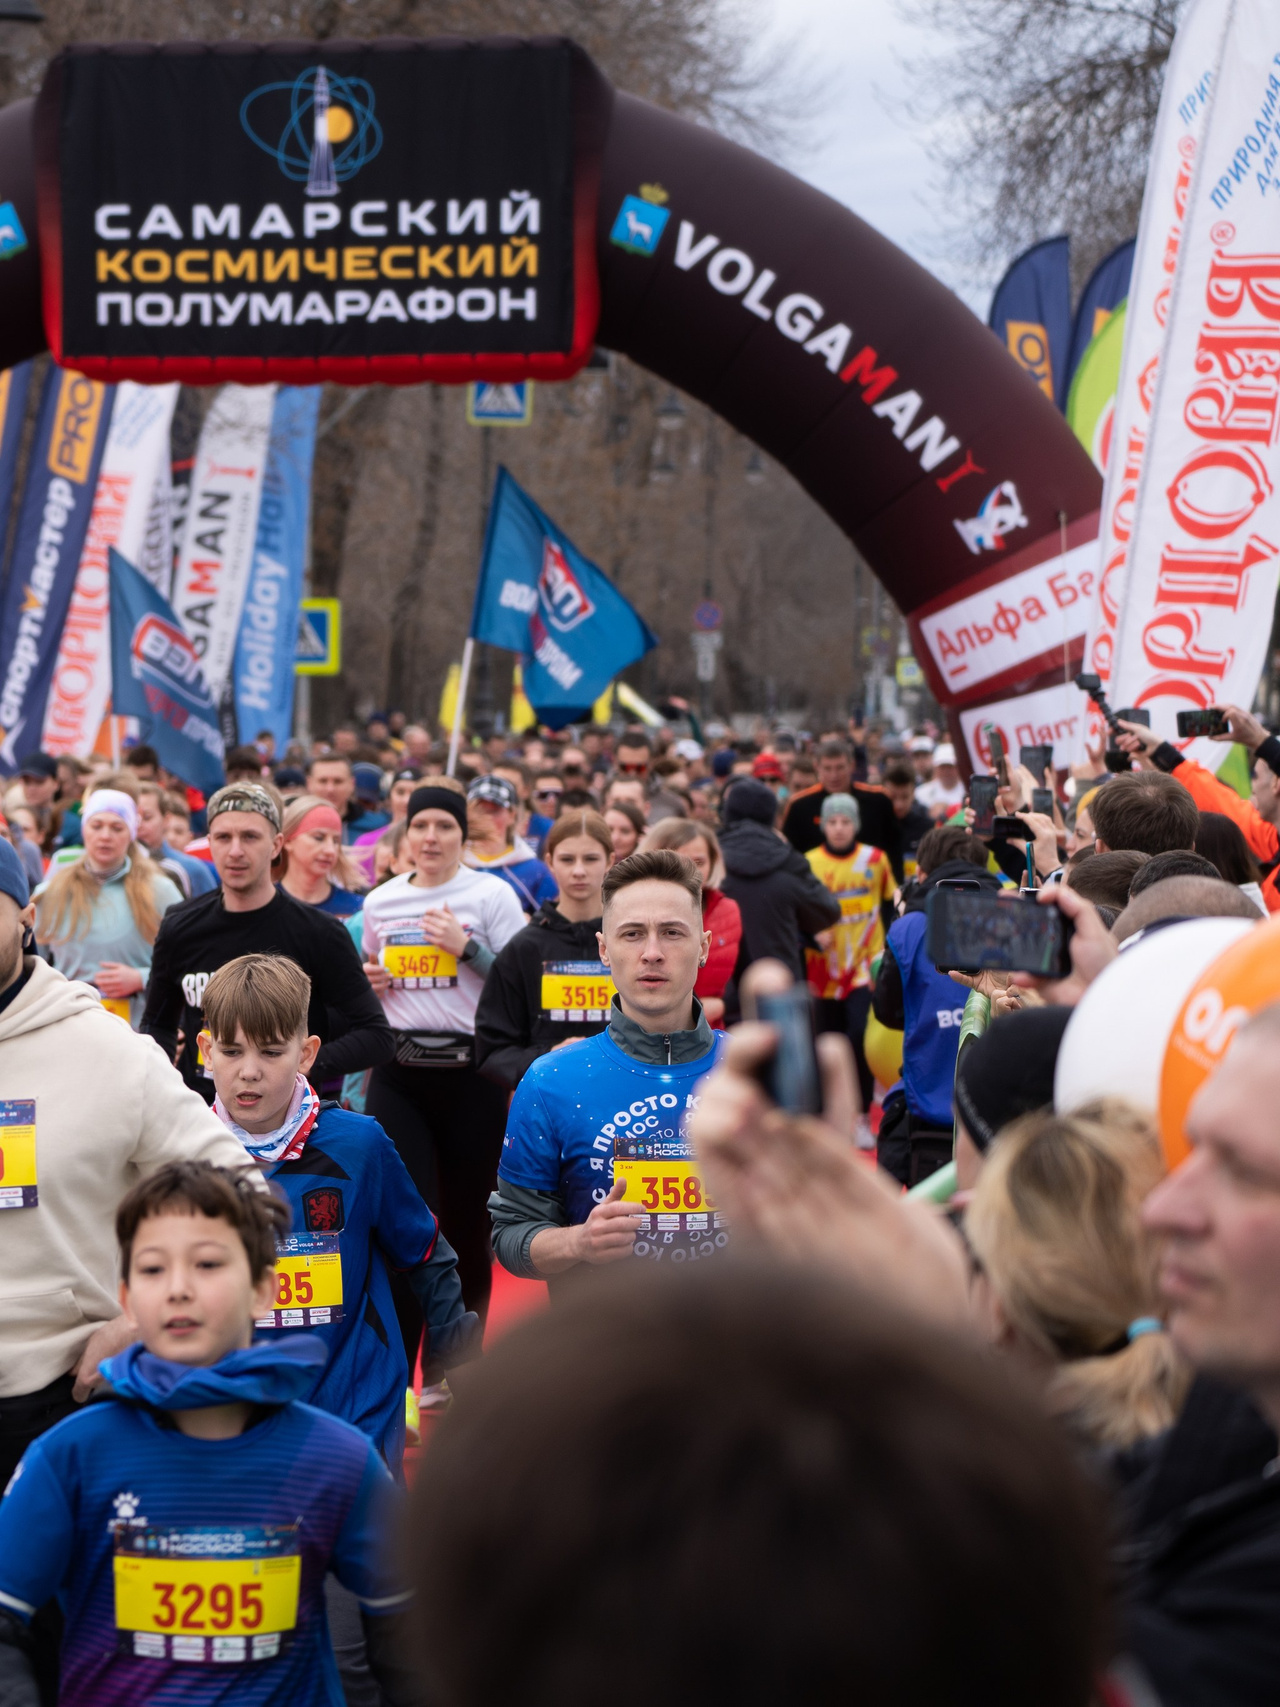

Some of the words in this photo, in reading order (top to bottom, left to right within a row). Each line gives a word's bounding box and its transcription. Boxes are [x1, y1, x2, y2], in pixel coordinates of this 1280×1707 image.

[95, 191, 541, 240] САМАРСКИЙ
[96, 238, 539, 283] КОСМИЧЕСКИЙ
[96, 286, 538, 327] ПОЛУМАРАФОН
[672, 220, 960, 474] VOLGAMAN
[57, 376, 95, 473] PRO
[238, 551, 289, 711] Holiday
[934, 595, 1048, 664] Альфа
[1046, 570, 1095, 610] Ба
[398, 954, 440, 975] 3467
[562, 986, 608, 1007] 3515
[593, 1093, 678, 1153] ПРОСТО
[275, 1271, 313, 1306] 85
[152, 1582, 263, 1630] 3295
